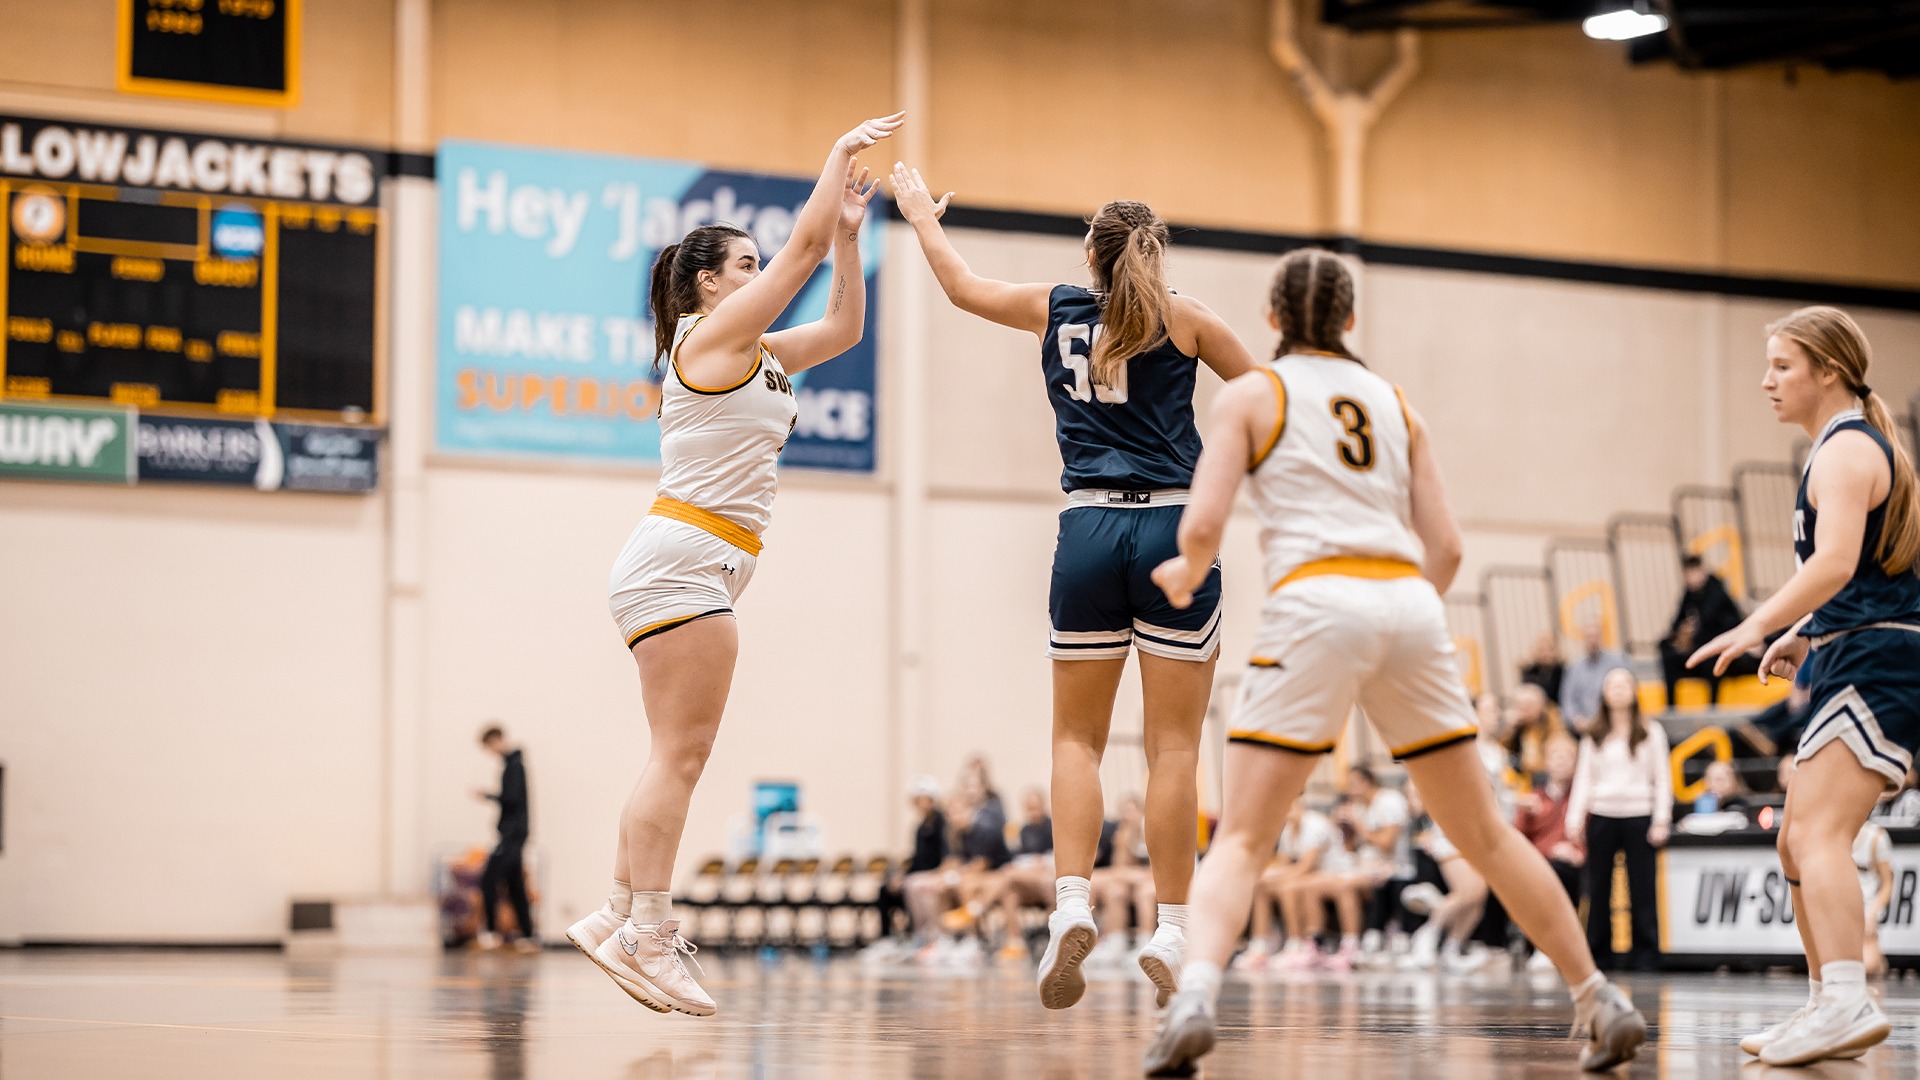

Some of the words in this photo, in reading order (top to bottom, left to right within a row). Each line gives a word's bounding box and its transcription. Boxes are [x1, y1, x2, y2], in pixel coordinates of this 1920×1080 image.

[1, 122, 376, 204] LOWJACKETS
[456, 165, 591, 258] Hey
[455, 304, 592, 363] MAKE
[457, 367, 661, 421] SUPERIO
[0, 414, 118, 467] WAY
[1330, 394, 1376, 471] 3
